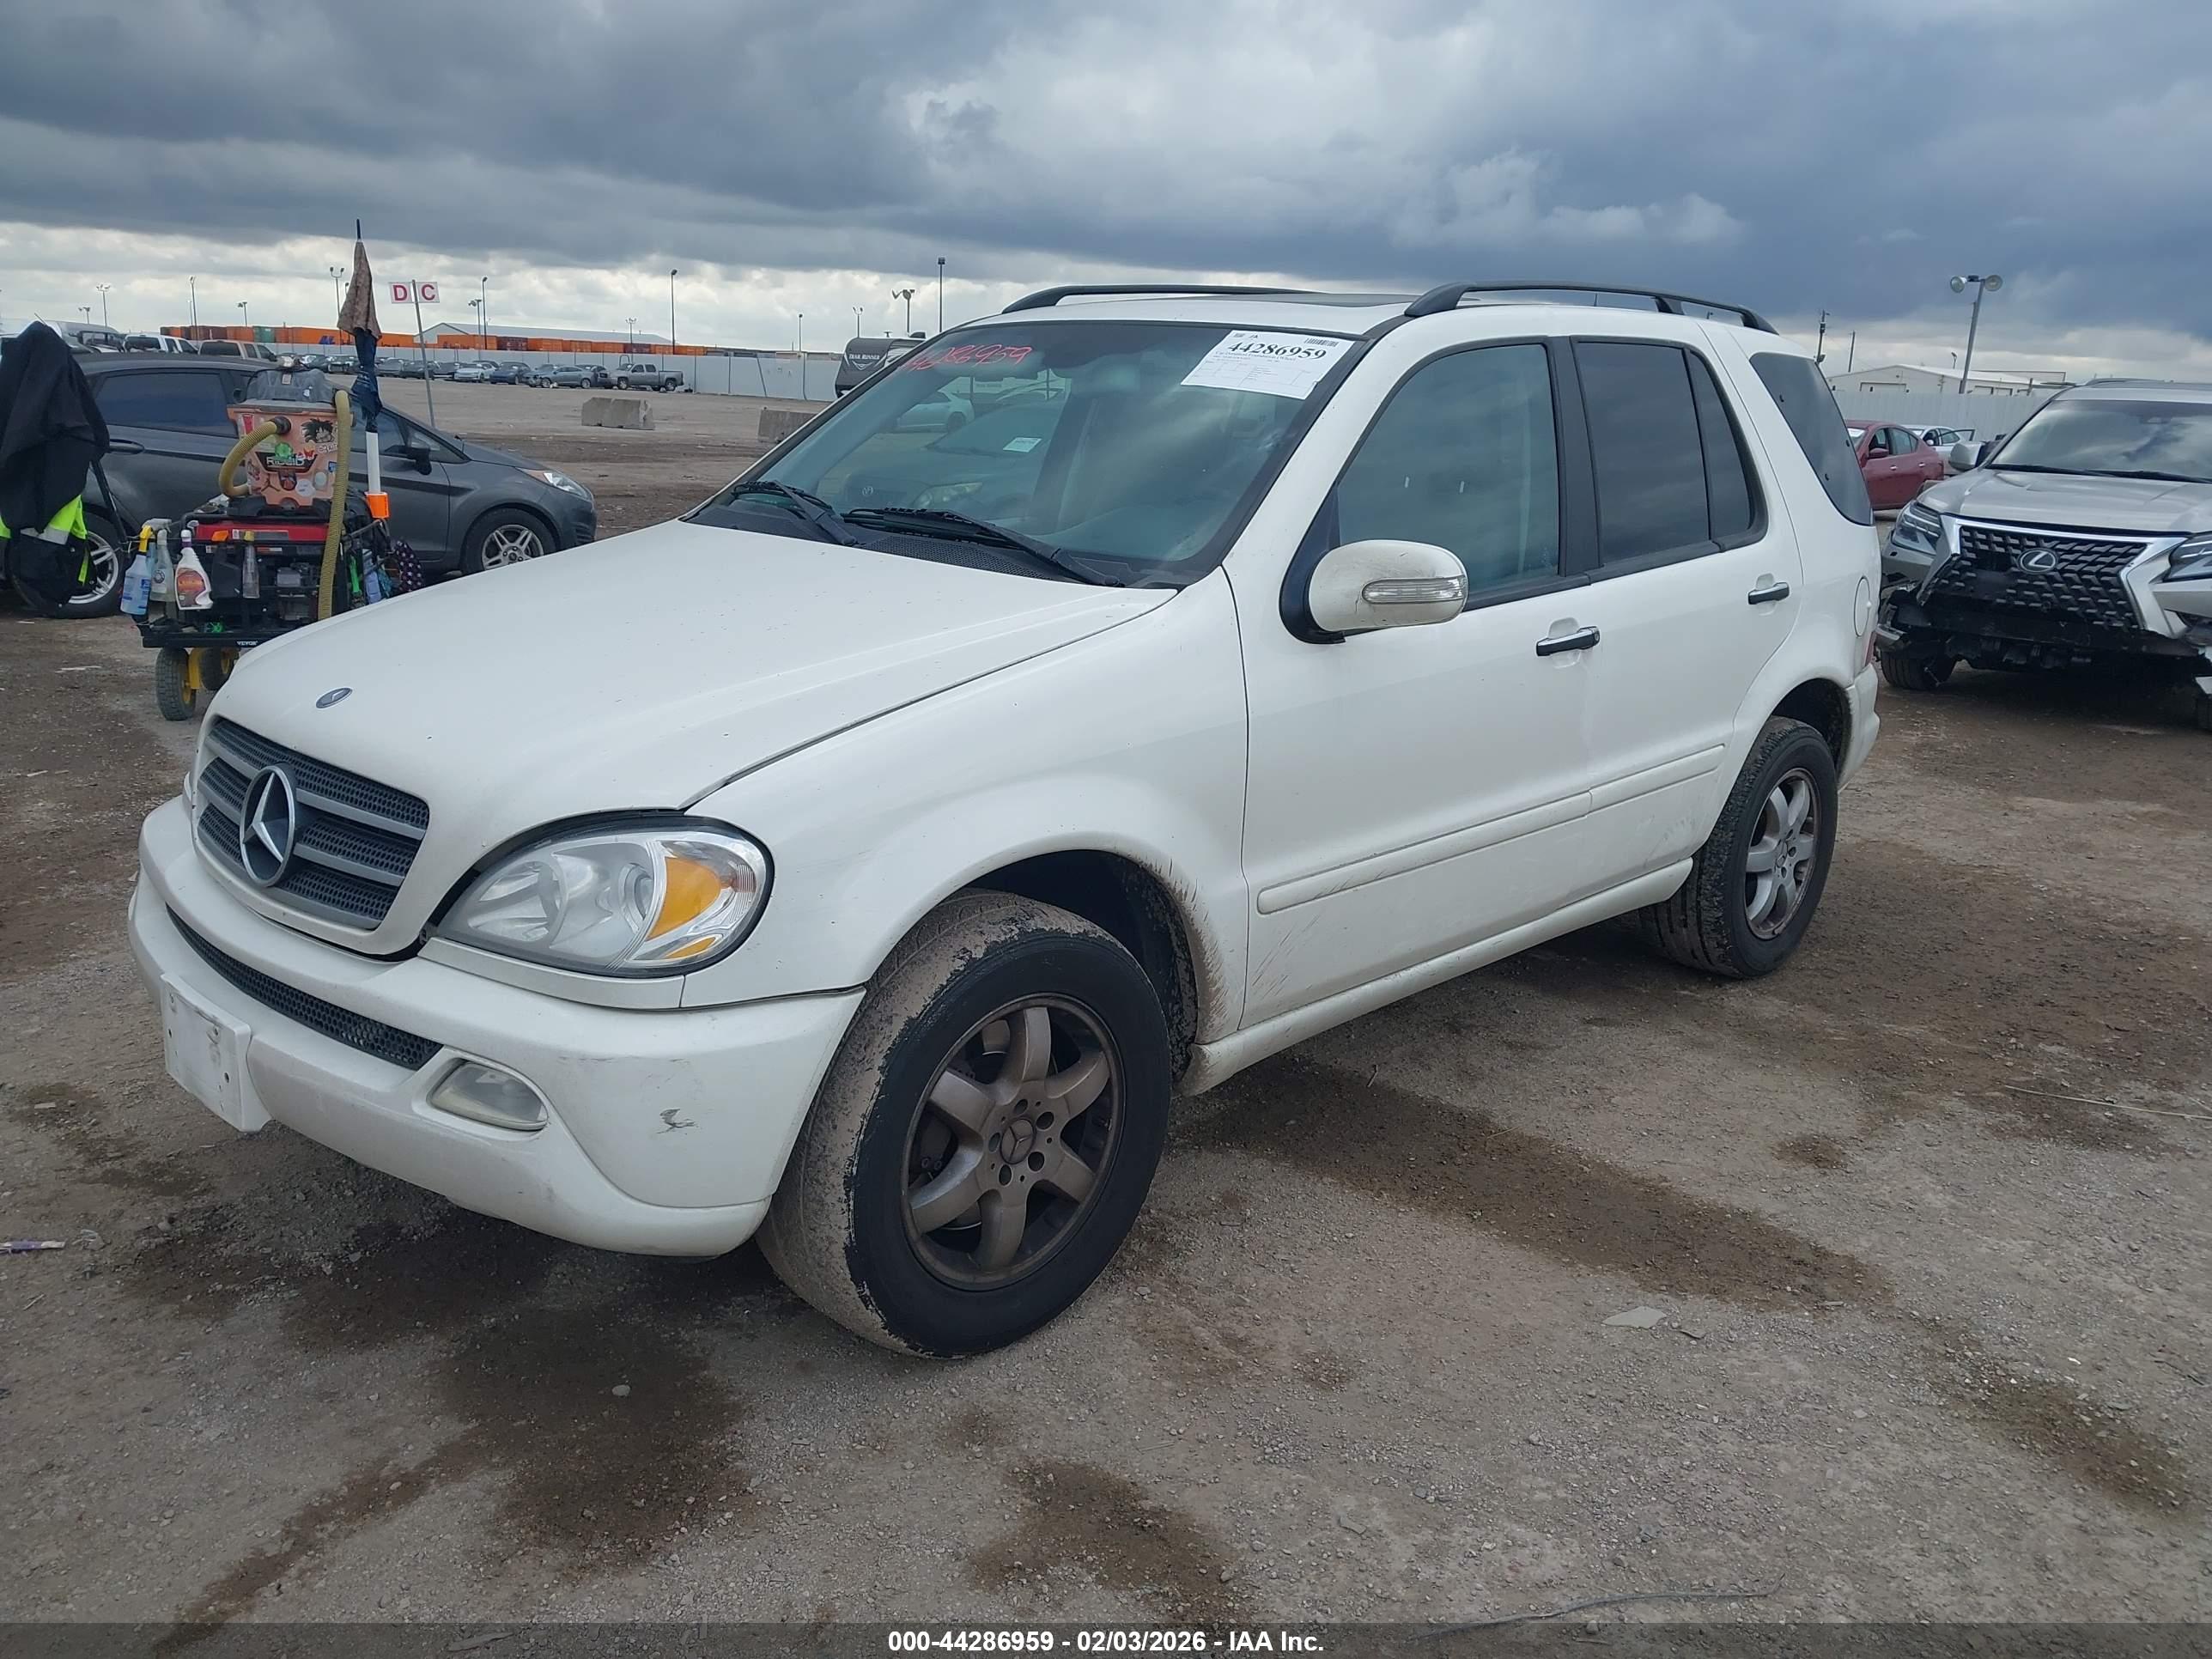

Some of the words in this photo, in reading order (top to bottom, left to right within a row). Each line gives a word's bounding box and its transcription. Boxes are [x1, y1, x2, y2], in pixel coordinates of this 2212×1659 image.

[392, 284, 408, 301] D
[421, 283, 435, 301] C
[1227, 341, 1327, 360] 44286959
